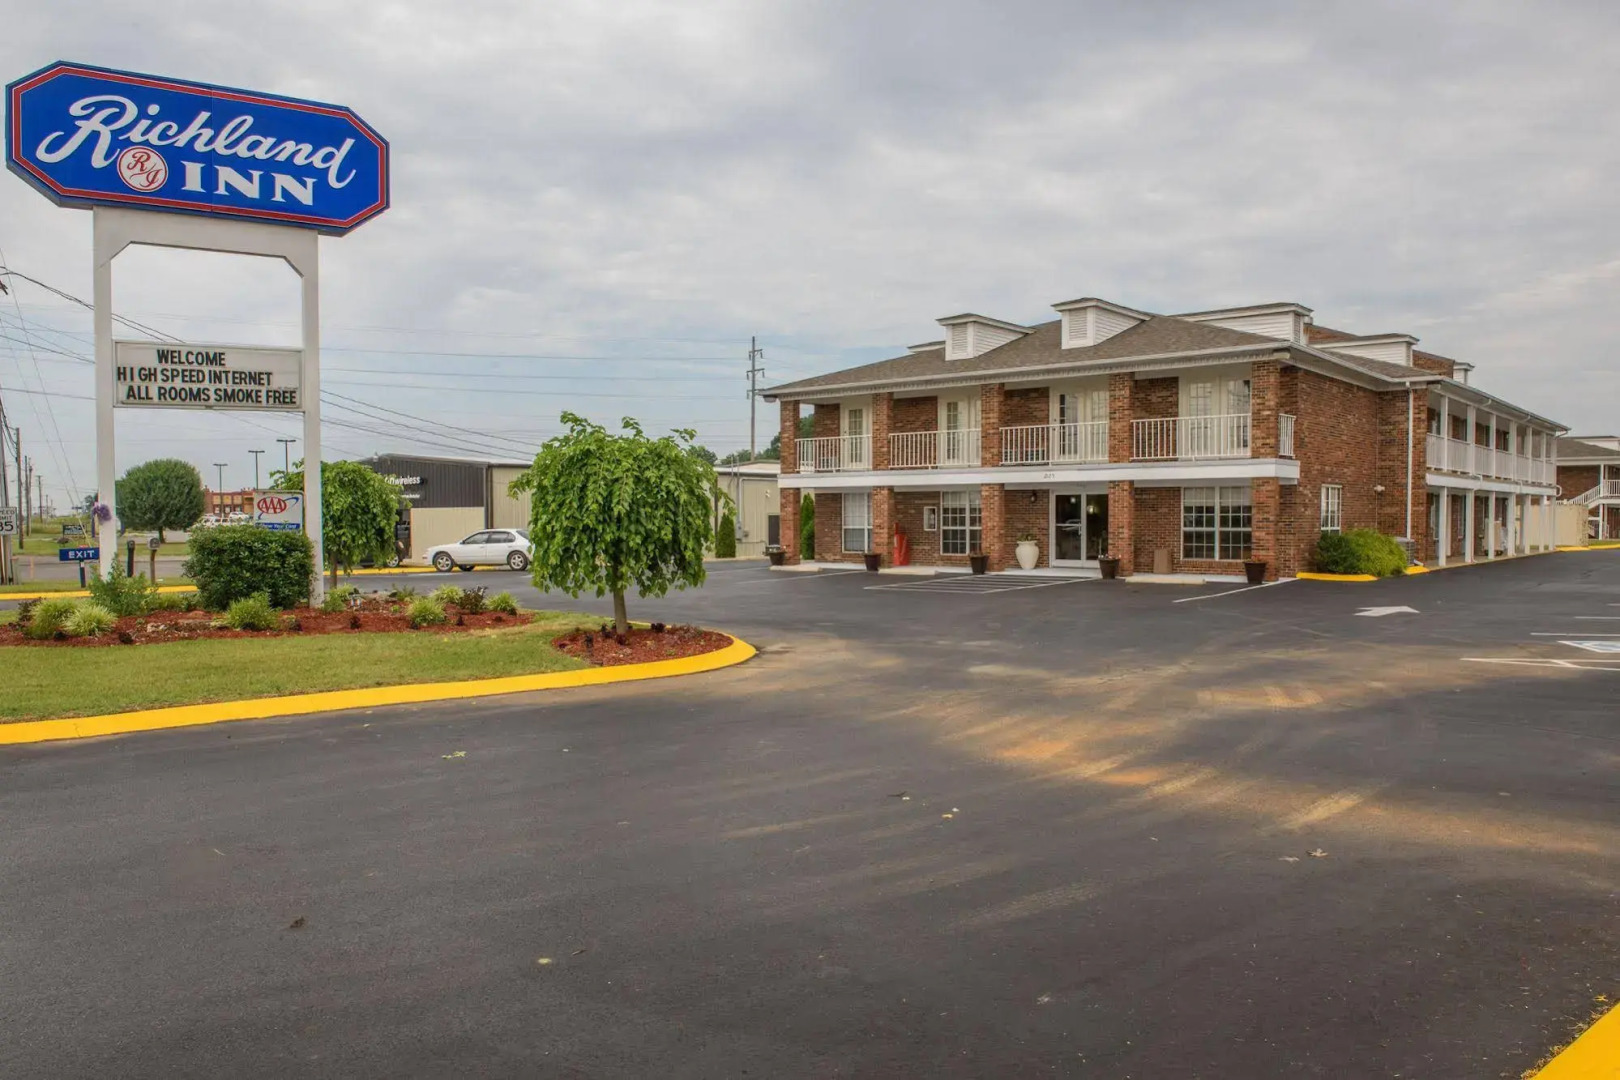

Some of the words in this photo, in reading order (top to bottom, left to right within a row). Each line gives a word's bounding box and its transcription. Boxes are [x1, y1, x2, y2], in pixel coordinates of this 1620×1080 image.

[35, 94, 357, 189] Richland
[180, 160, 318, 206] INN
[156, 349, 226, 366] WELCOME
[117, 366, 157, 382] HIGH
[160, 368, 205, 384] SPEED
[208, 371, 273, 386] INTERNET
[126, 385, 153, 400] ALL
[158, 386, 211, 402] ROOMS
[214, 387, 262, 404] SMOKE
[266, 389, 297, 405] FREE
[257, 496, 287, 514] AAA
[68, 550, 95, 559] EXIT
